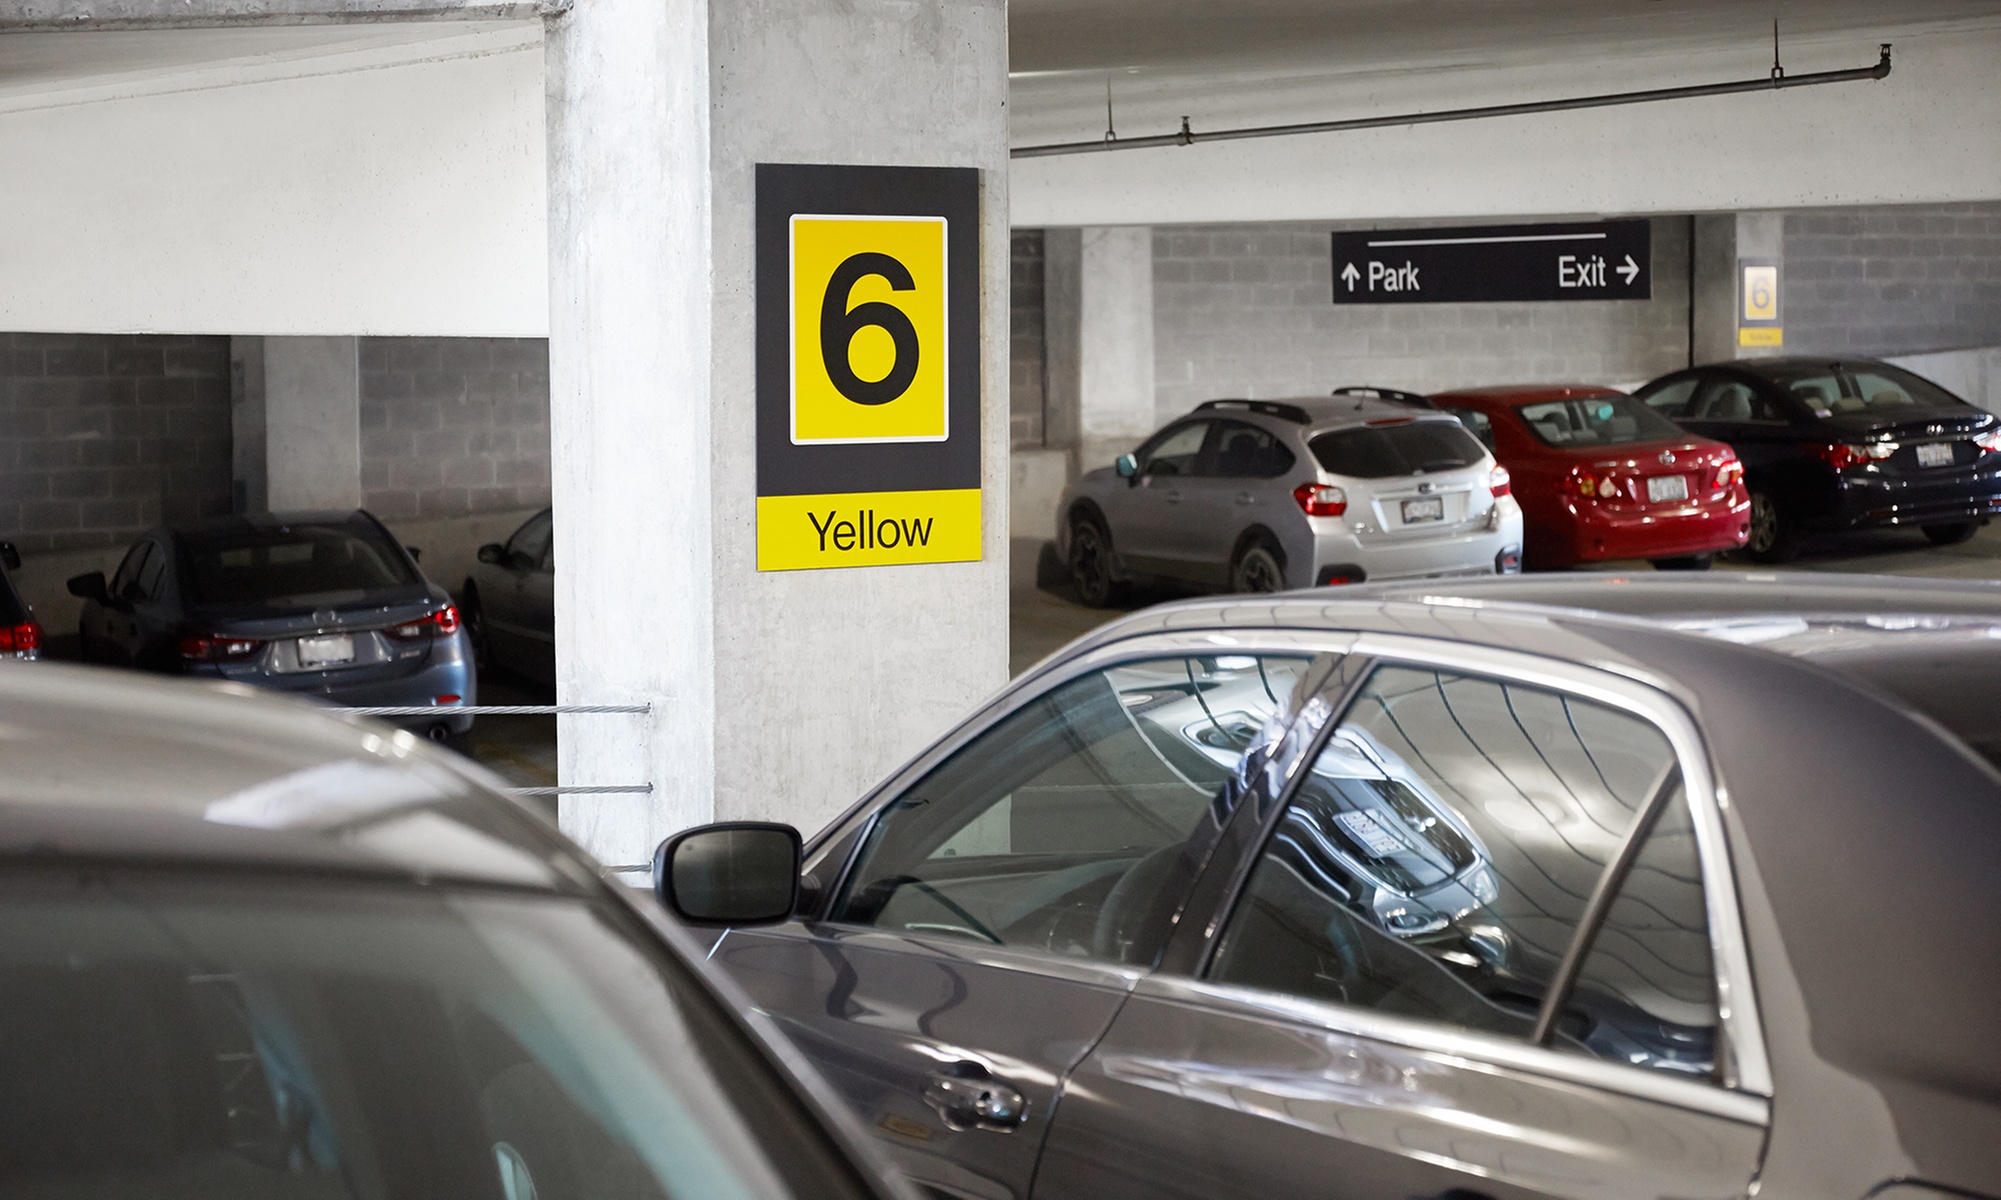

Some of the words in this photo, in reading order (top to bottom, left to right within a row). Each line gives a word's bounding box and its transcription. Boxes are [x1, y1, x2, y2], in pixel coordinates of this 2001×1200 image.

[1368, 259, 1421, 292] Park
[1558, 254, 1607, 288] Exit
[1752, 277, 1770, 310] 6
[820, 252, 919, 406] 6
[806, 508, 934, 552] Yellow
